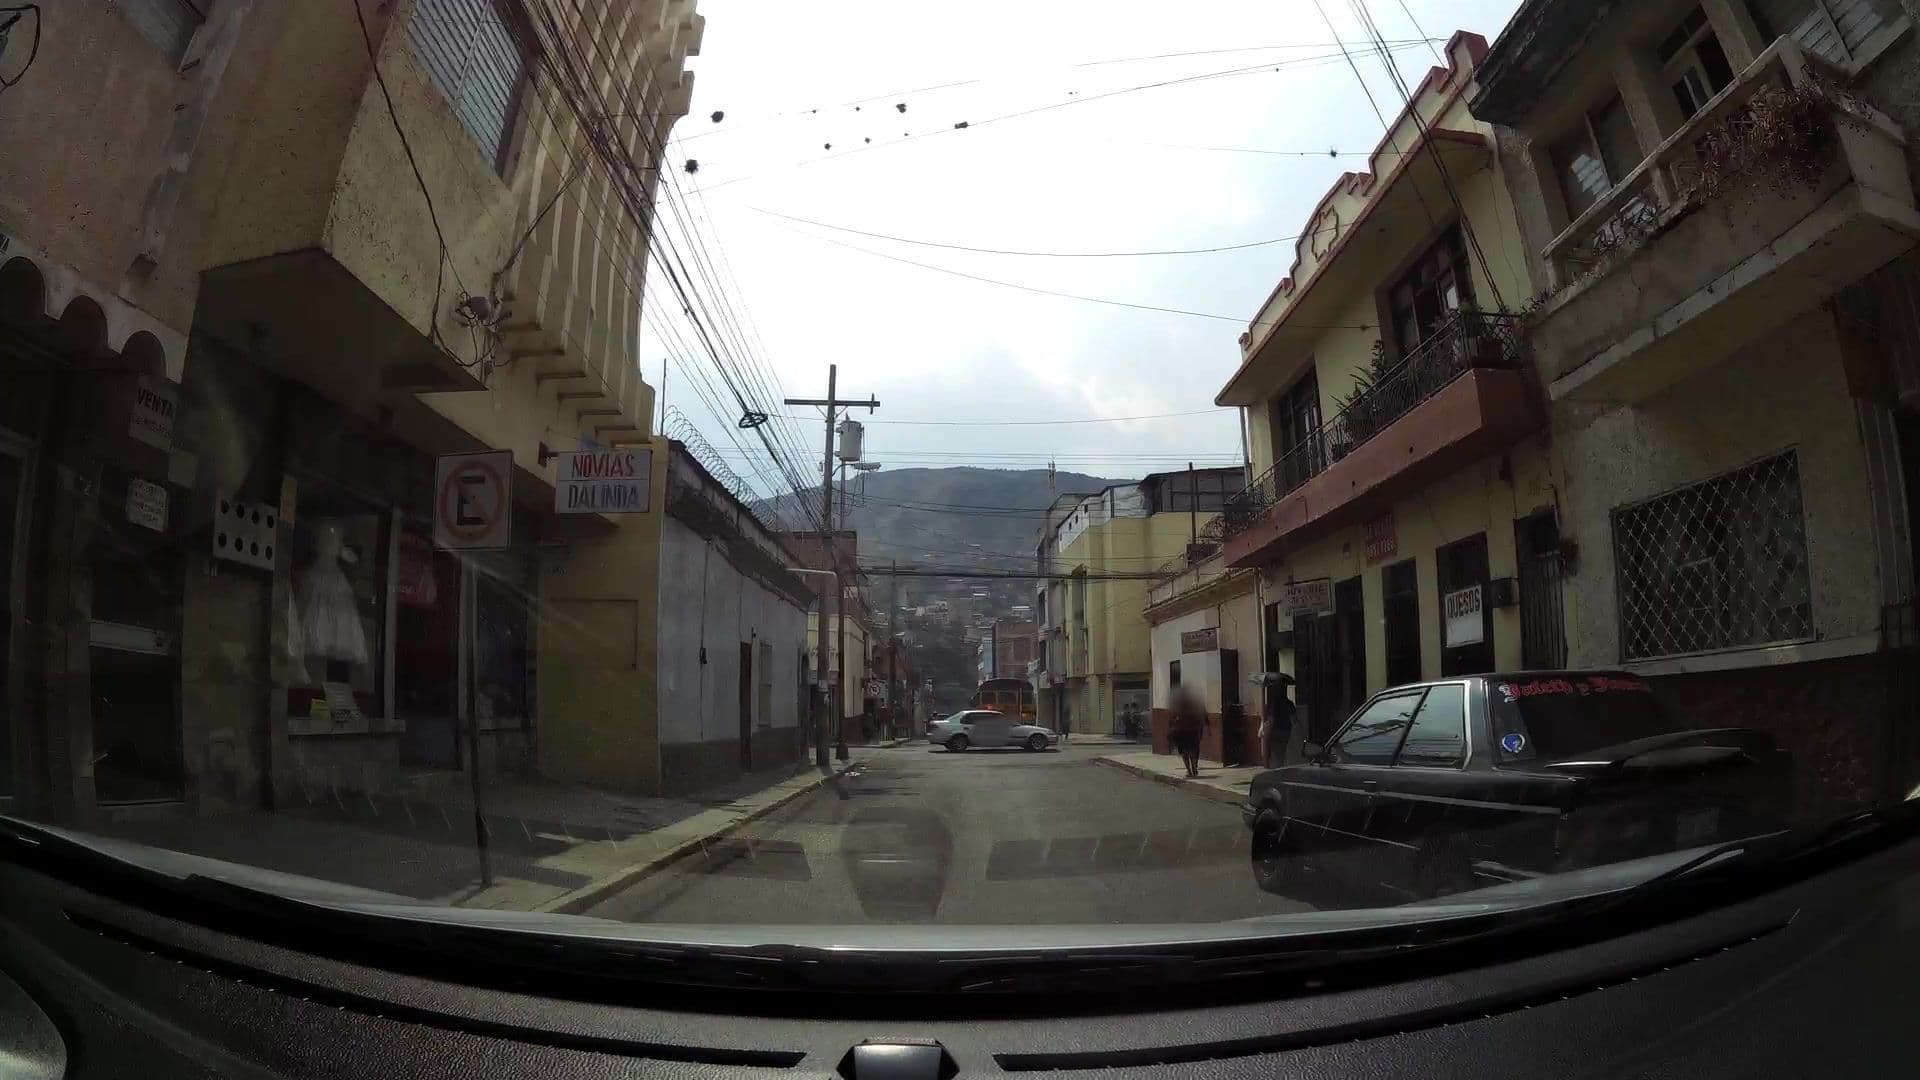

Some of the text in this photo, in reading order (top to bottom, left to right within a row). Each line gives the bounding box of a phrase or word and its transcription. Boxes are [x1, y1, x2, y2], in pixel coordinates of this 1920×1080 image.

[572, 453, 634, 478] NOVIAS
[457, 475, 486, 526] E
[568, 484, 640, 509] DALINDA
[1448, 588, 1481, 618] QUESOS
